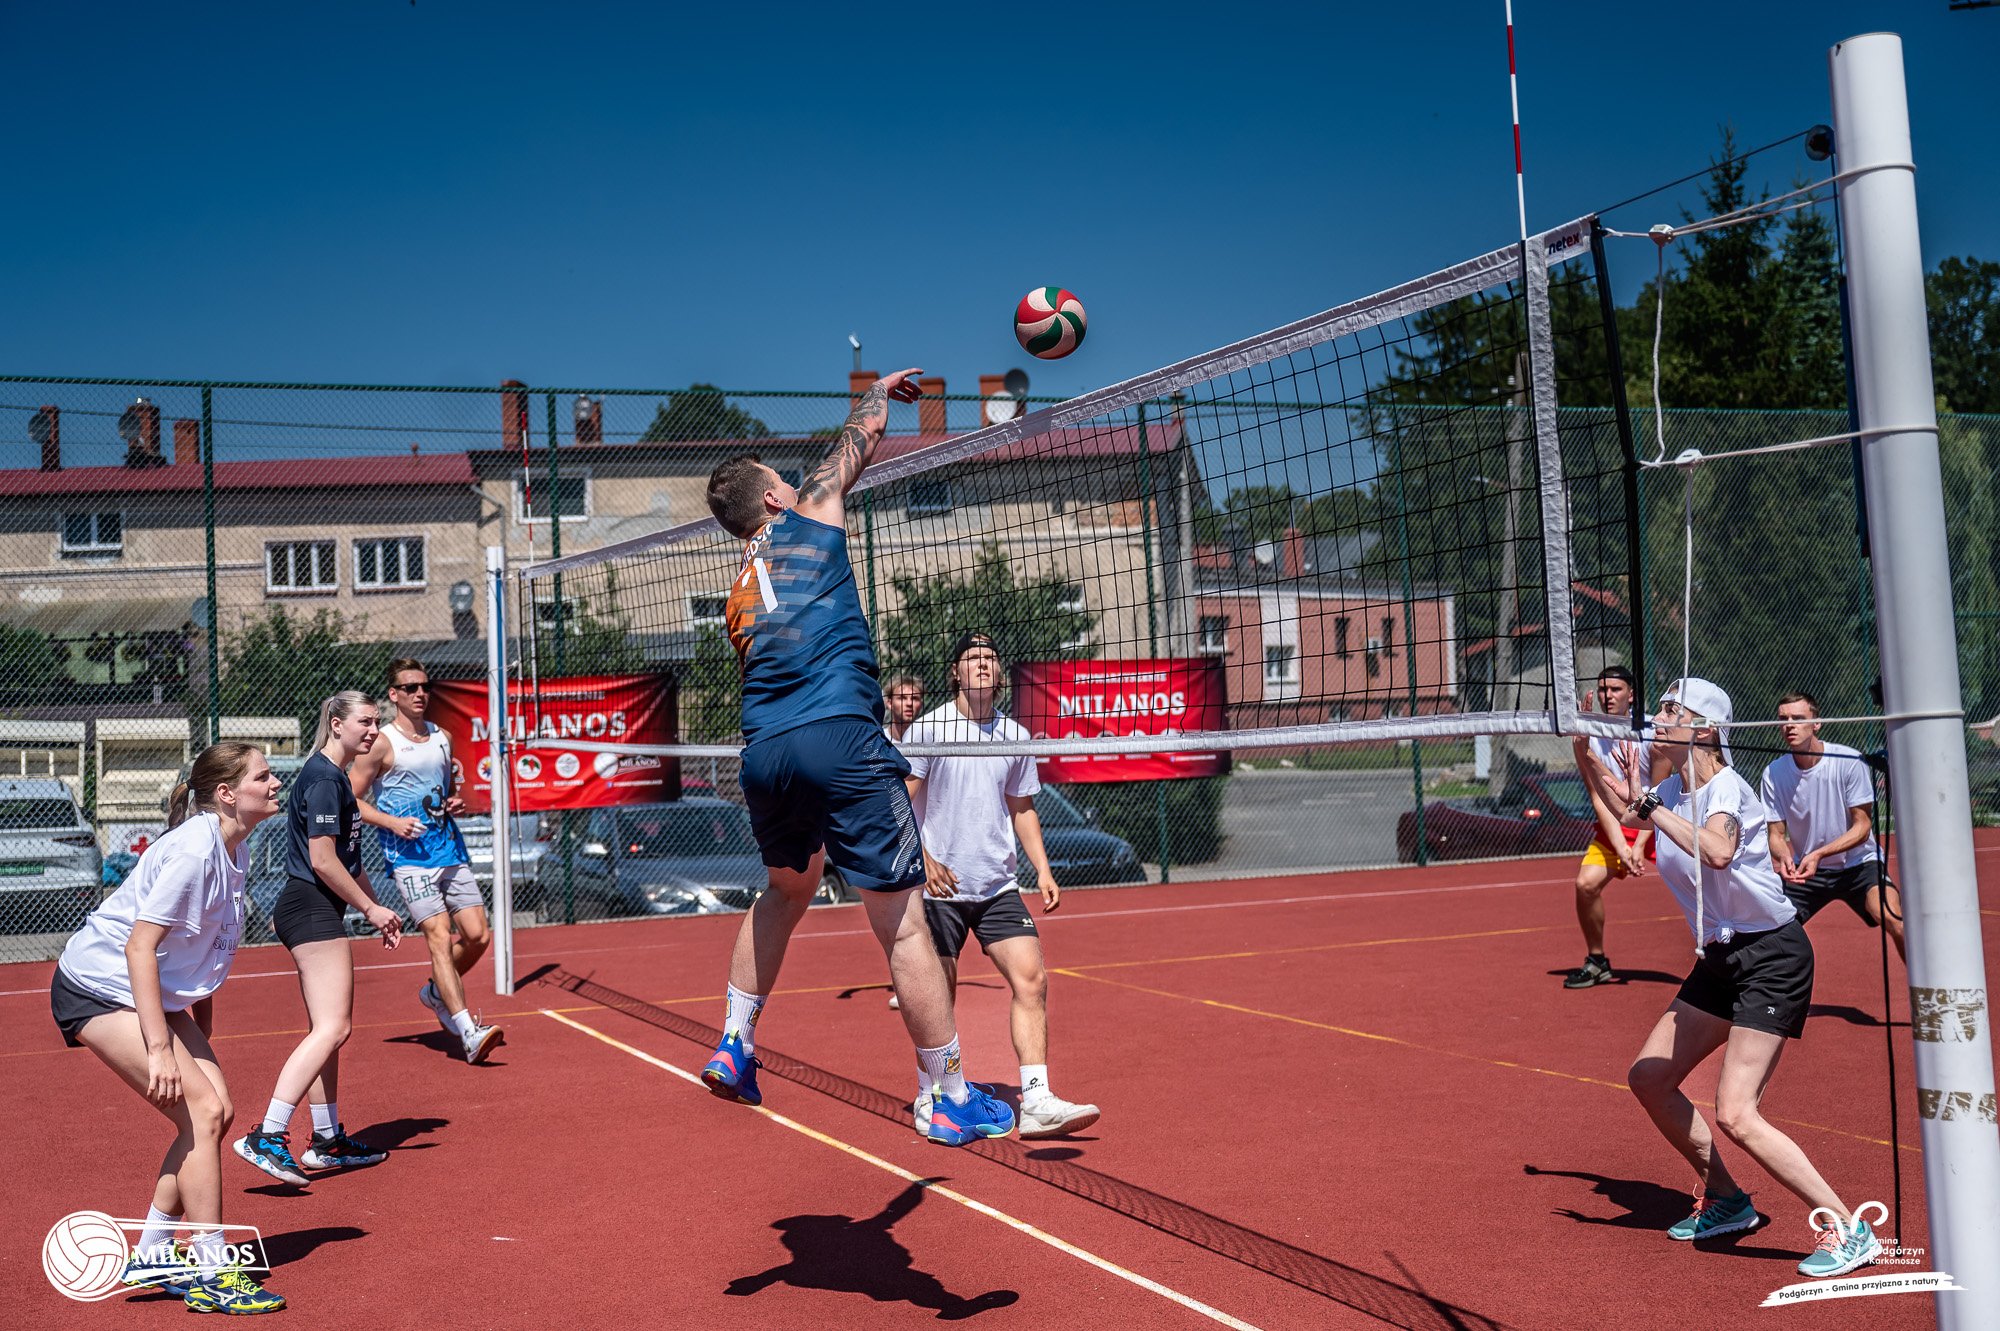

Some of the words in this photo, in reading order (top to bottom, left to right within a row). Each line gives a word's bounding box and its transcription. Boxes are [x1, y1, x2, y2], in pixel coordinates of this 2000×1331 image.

[1548, 233, 1580, 254] netex
[1057, 691, 1187, 719] MILANOS
[471, 711, 628, 742] MILANOS
[403, 873, 437, 903] 11
